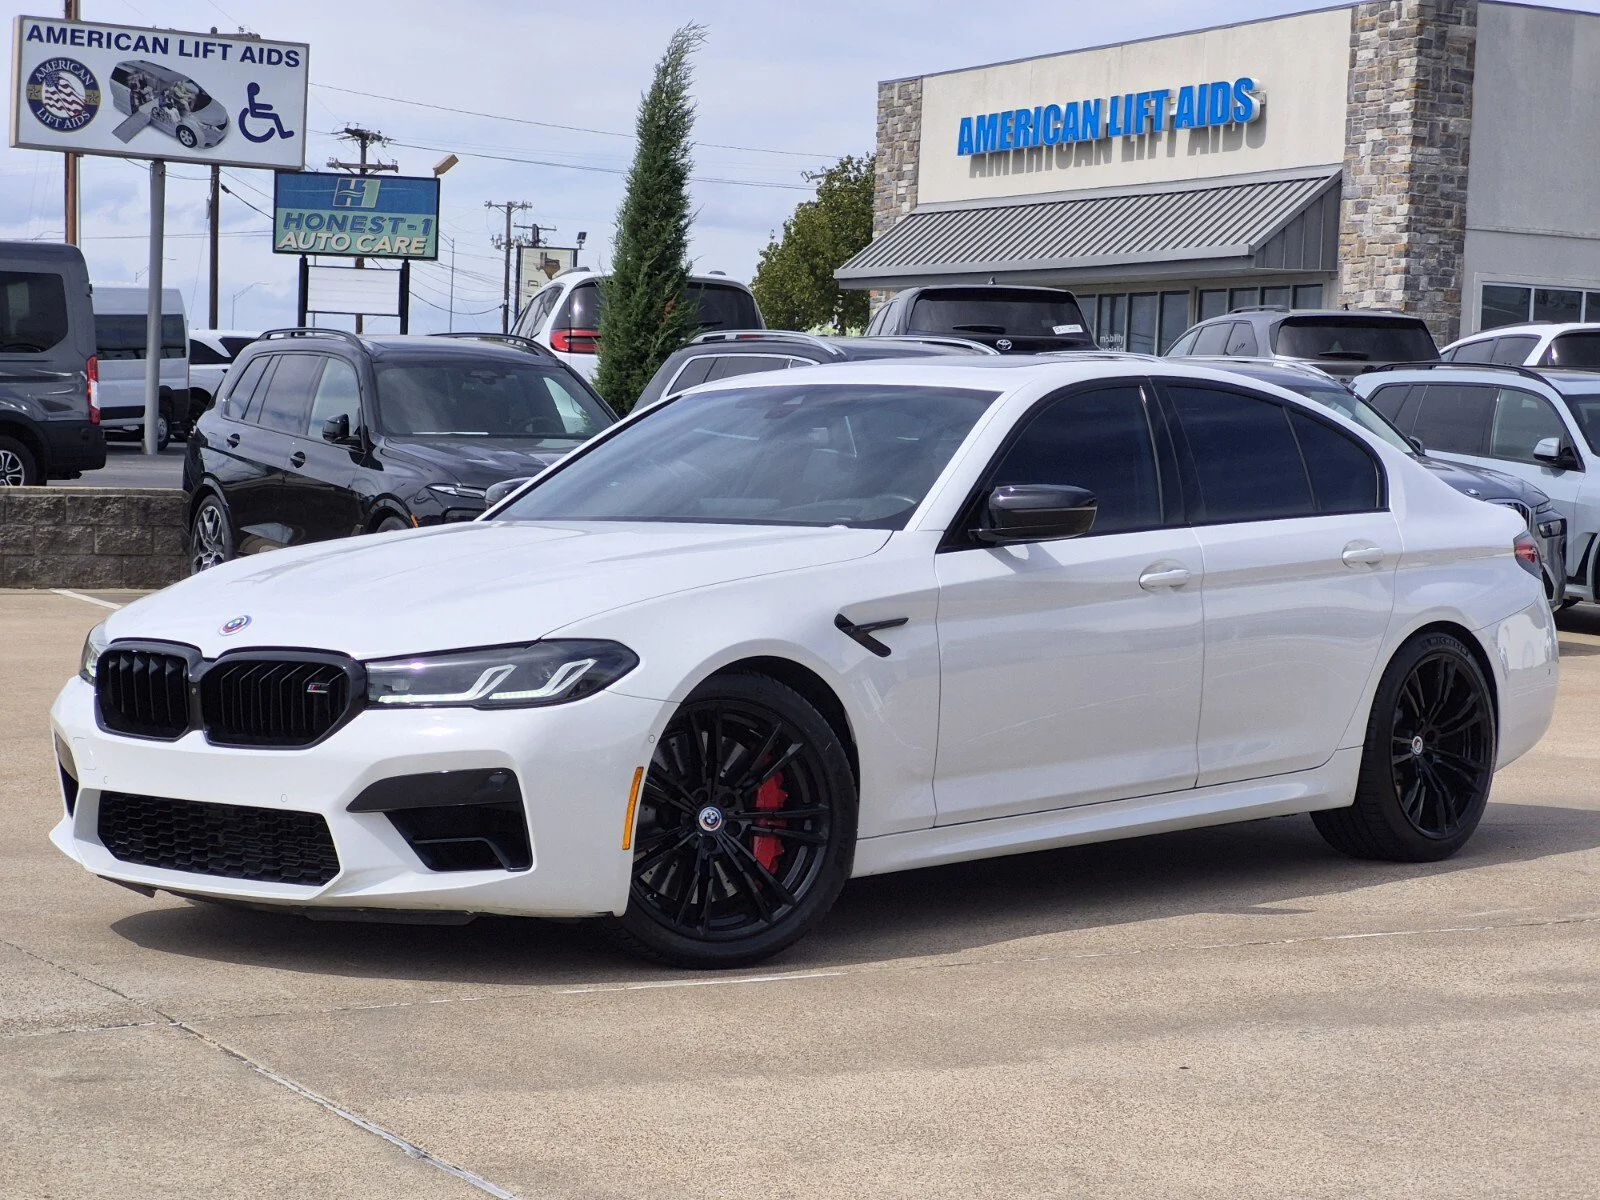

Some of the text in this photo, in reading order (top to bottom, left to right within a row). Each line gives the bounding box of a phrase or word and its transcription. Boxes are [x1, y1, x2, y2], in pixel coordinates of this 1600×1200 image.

[26, 24, 300, 68] AMERICAN LIFT AIDS
[35, 60, 94, 86] AMERICAN
[37, 107, 91, 129] LIFT AIDS
[957, 77, 1258, 156] AMERICAN LIFT AIDS
[283, 211, 433, 237] HONEST-1
[277, 231, 428, 255] AUTO CARE
